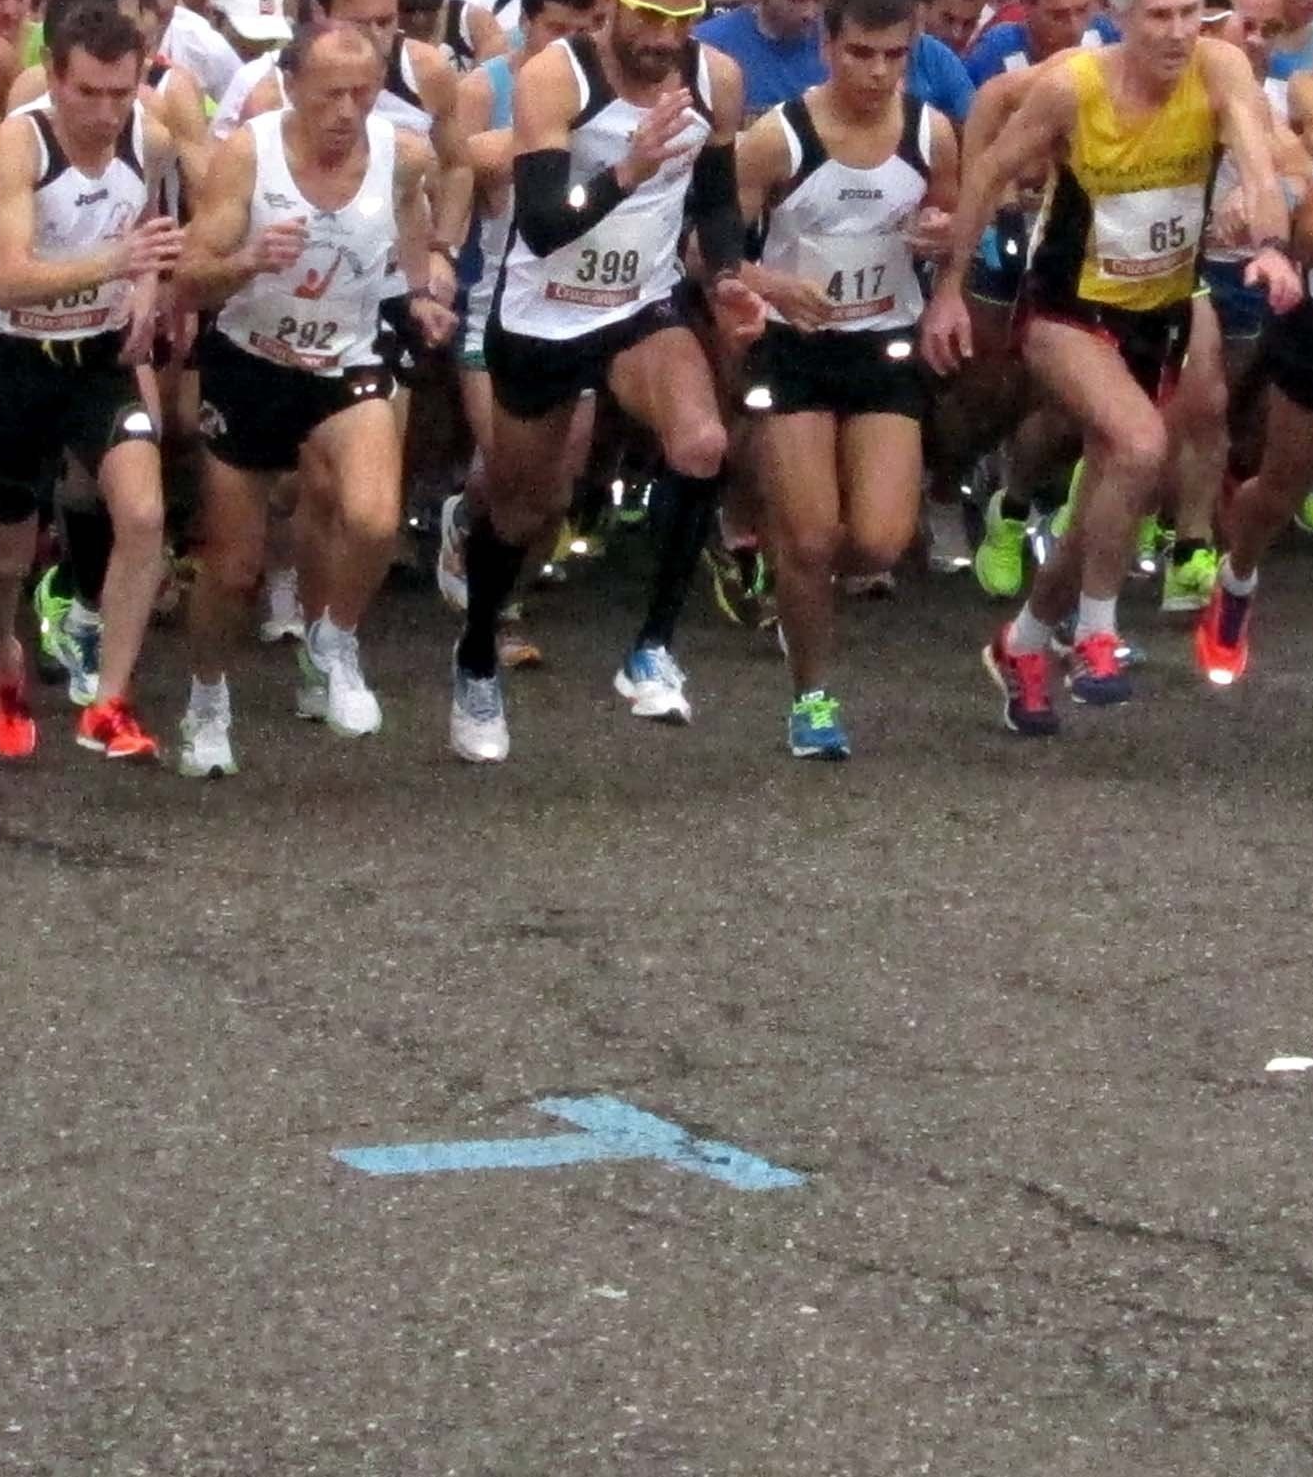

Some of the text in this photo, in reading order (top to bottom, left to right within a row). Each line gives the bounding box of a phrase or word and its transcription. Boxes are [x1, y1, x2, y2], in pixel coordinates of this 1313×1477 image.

[1149, 215, 1186, 253] 65
[576, 248, 640, 285] 399
[826, 265, 886, 302] 417
[276, 315, 339, 350] 292
